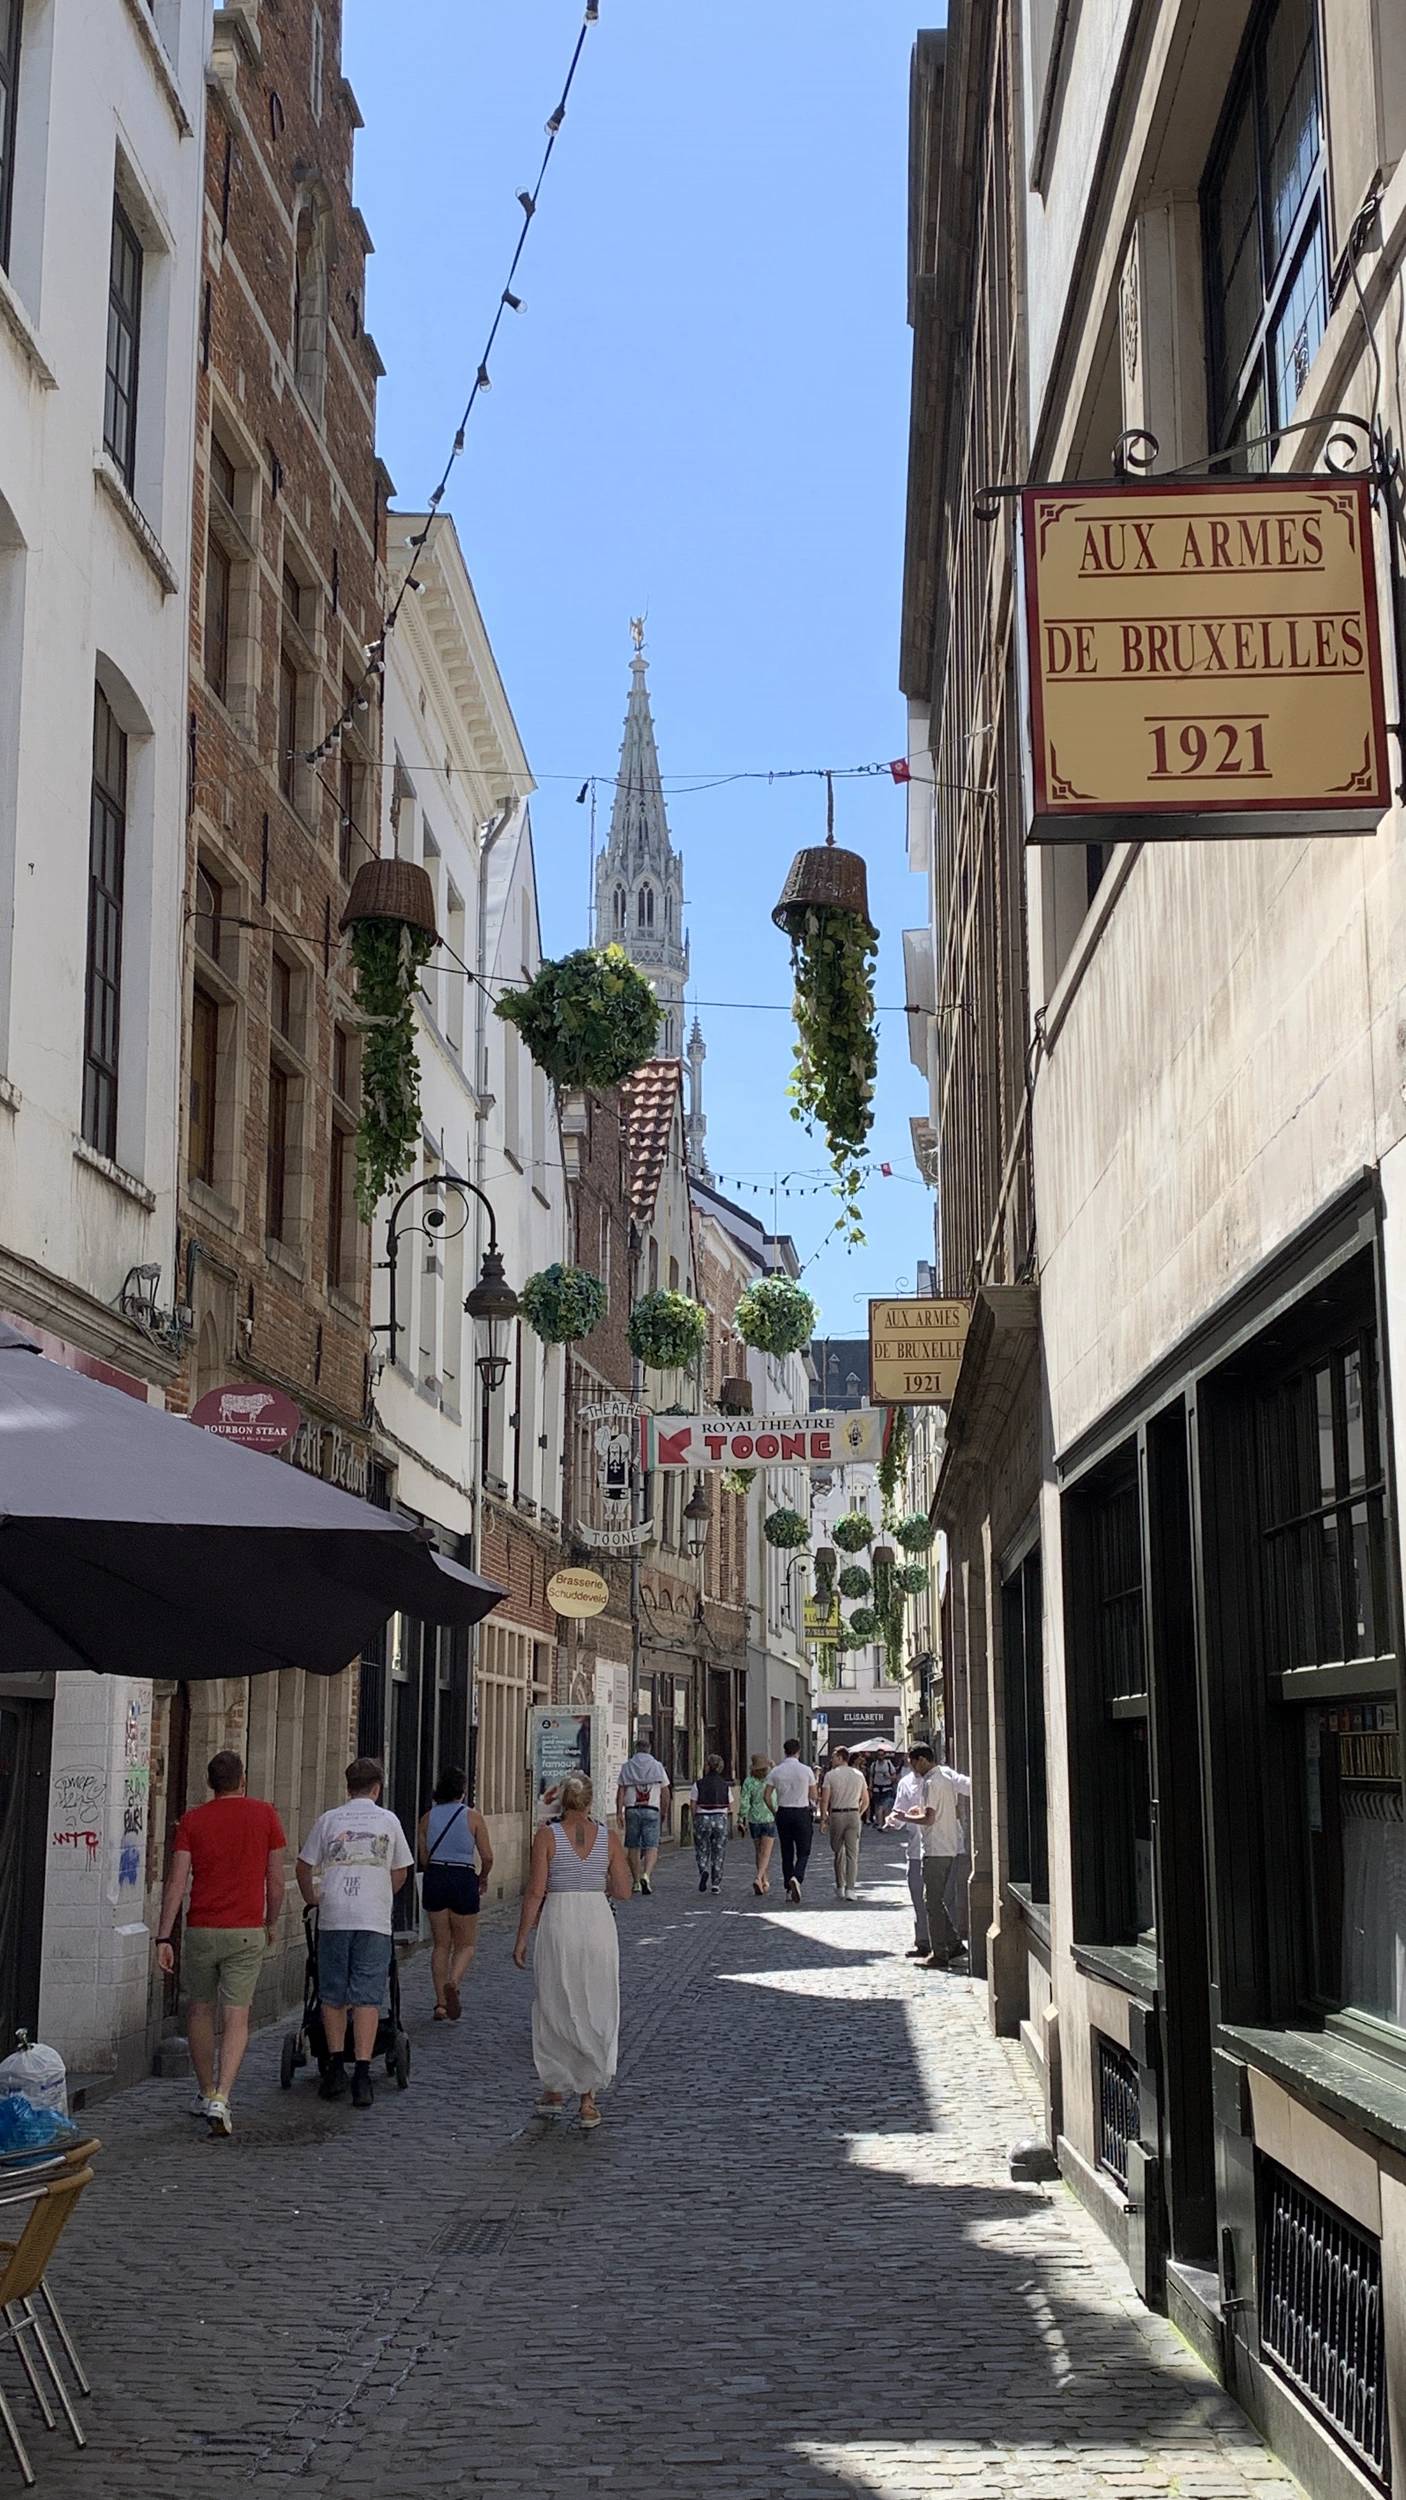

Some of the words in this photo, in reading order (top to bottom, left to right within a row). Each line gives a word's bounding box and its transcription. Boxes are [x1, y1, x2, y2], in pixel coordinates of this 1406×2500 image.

[1080, 522, 1158, 571] AUX
[1180, 516, 1324, 568] ARMES
[1045, 625, 1098, 674] DE
[1120, 618, 1364, 673] BRUXELLES
[1148, 723, 1271, 774] 1921
[885, 1310, 909, 1327] AUX
[916, 1309, 960, 1326] ARMES
[874, 1342, 890, 1359] DE
[897, 1341, 963, 1358] BRUXELLE
[905, 1375, 941, 1392] 1921
[587, 1401, 642, 1418] THEATRE
[204, 1424, 253, 1435] BOURBON
[255, 1427, 288, 1436] STEAK
[702, 1421, 756, 1433] ROYAL
[758, 1418, 835, 1431] THEATRE
[704, 1432, 832, 1460] TOONE
[593, 1530, 639, 1545] TOONE
[556, 1574, 603, 1590] Brasserie
[542, 1760, 576, 1768] famous
